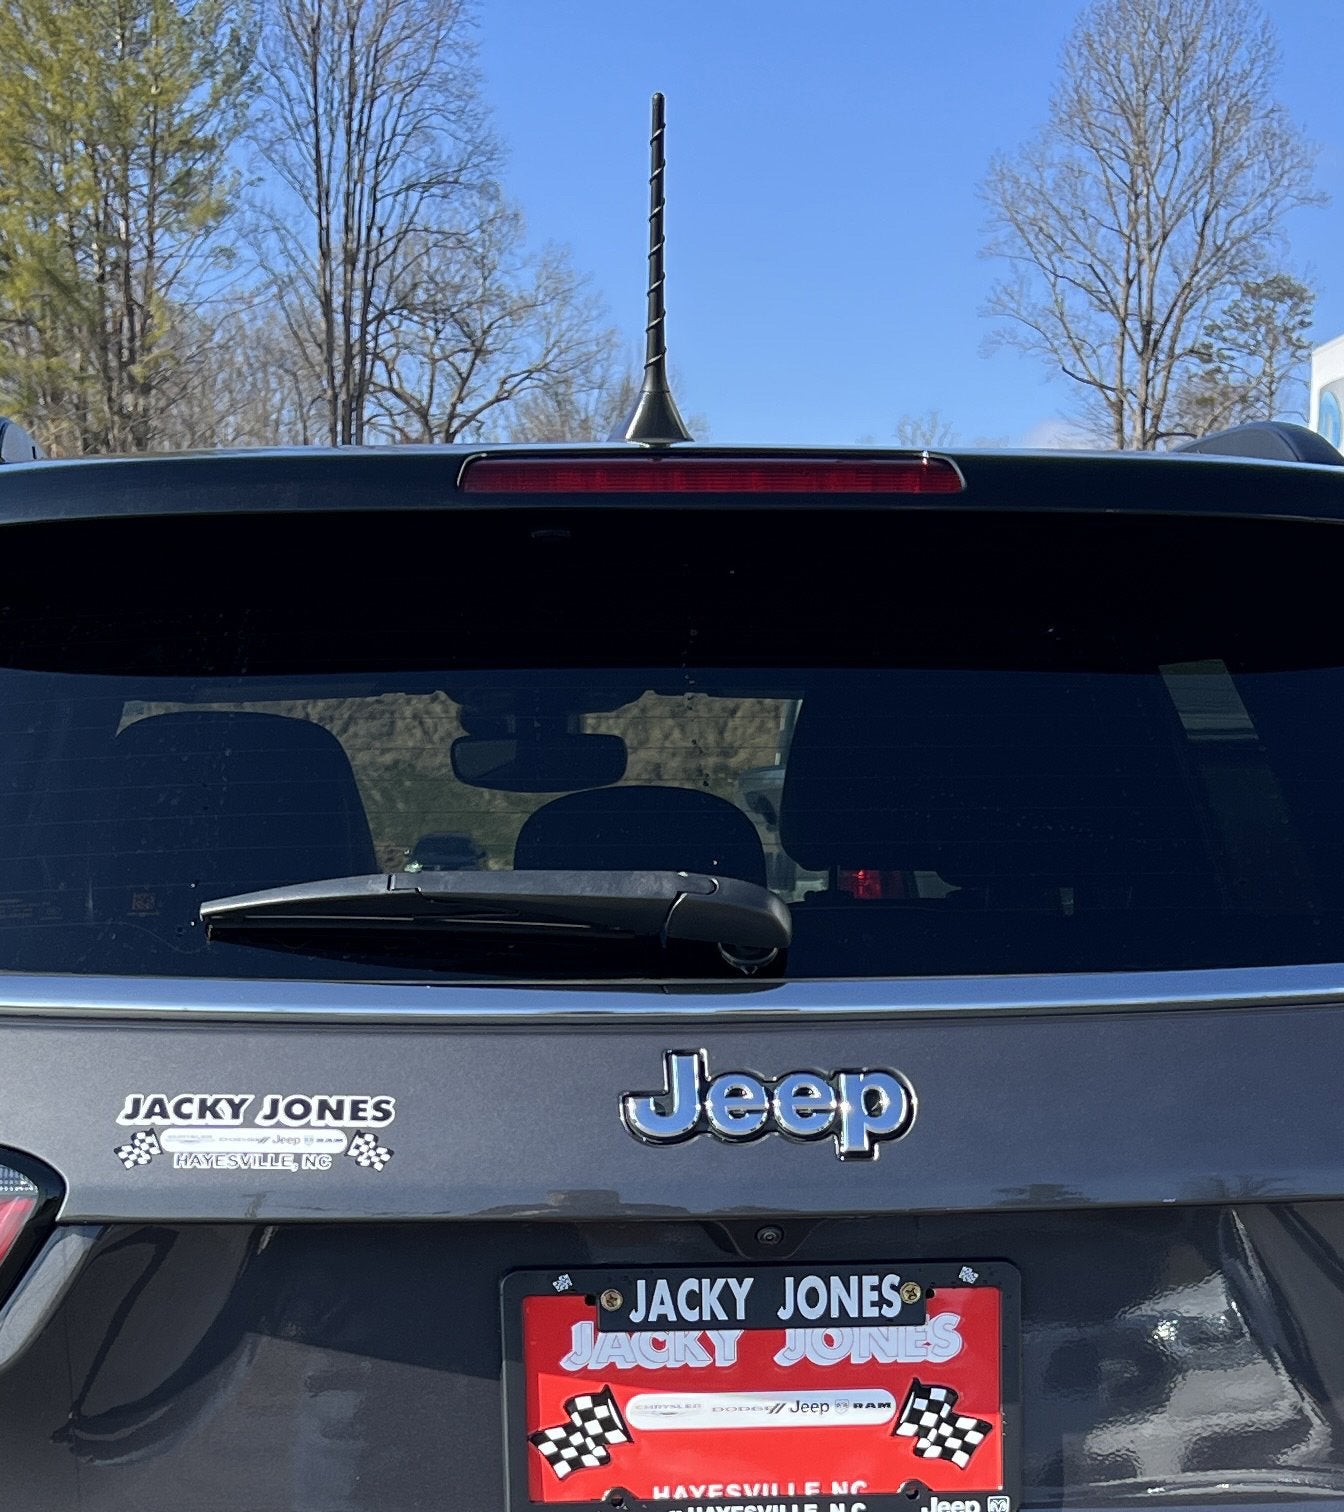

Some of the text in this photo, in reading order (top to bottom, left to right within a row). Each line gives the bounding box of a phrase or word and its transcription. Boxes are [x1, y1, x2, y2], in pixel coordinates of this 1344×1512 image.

[117, 1094, 395, 1127] JACKY JONES
[619, 1048, 917, 1162] Jeep
[174, 1153, 332, 1171] HAYESVILLE, NC
[629, 1273, 903, 1323] JACKY JONES
[560, 1312, 962, 1371] JACKY JONES
[789, 1399, 830, 1415] Jeep
[853, 1401, 892, 1410] RAM
